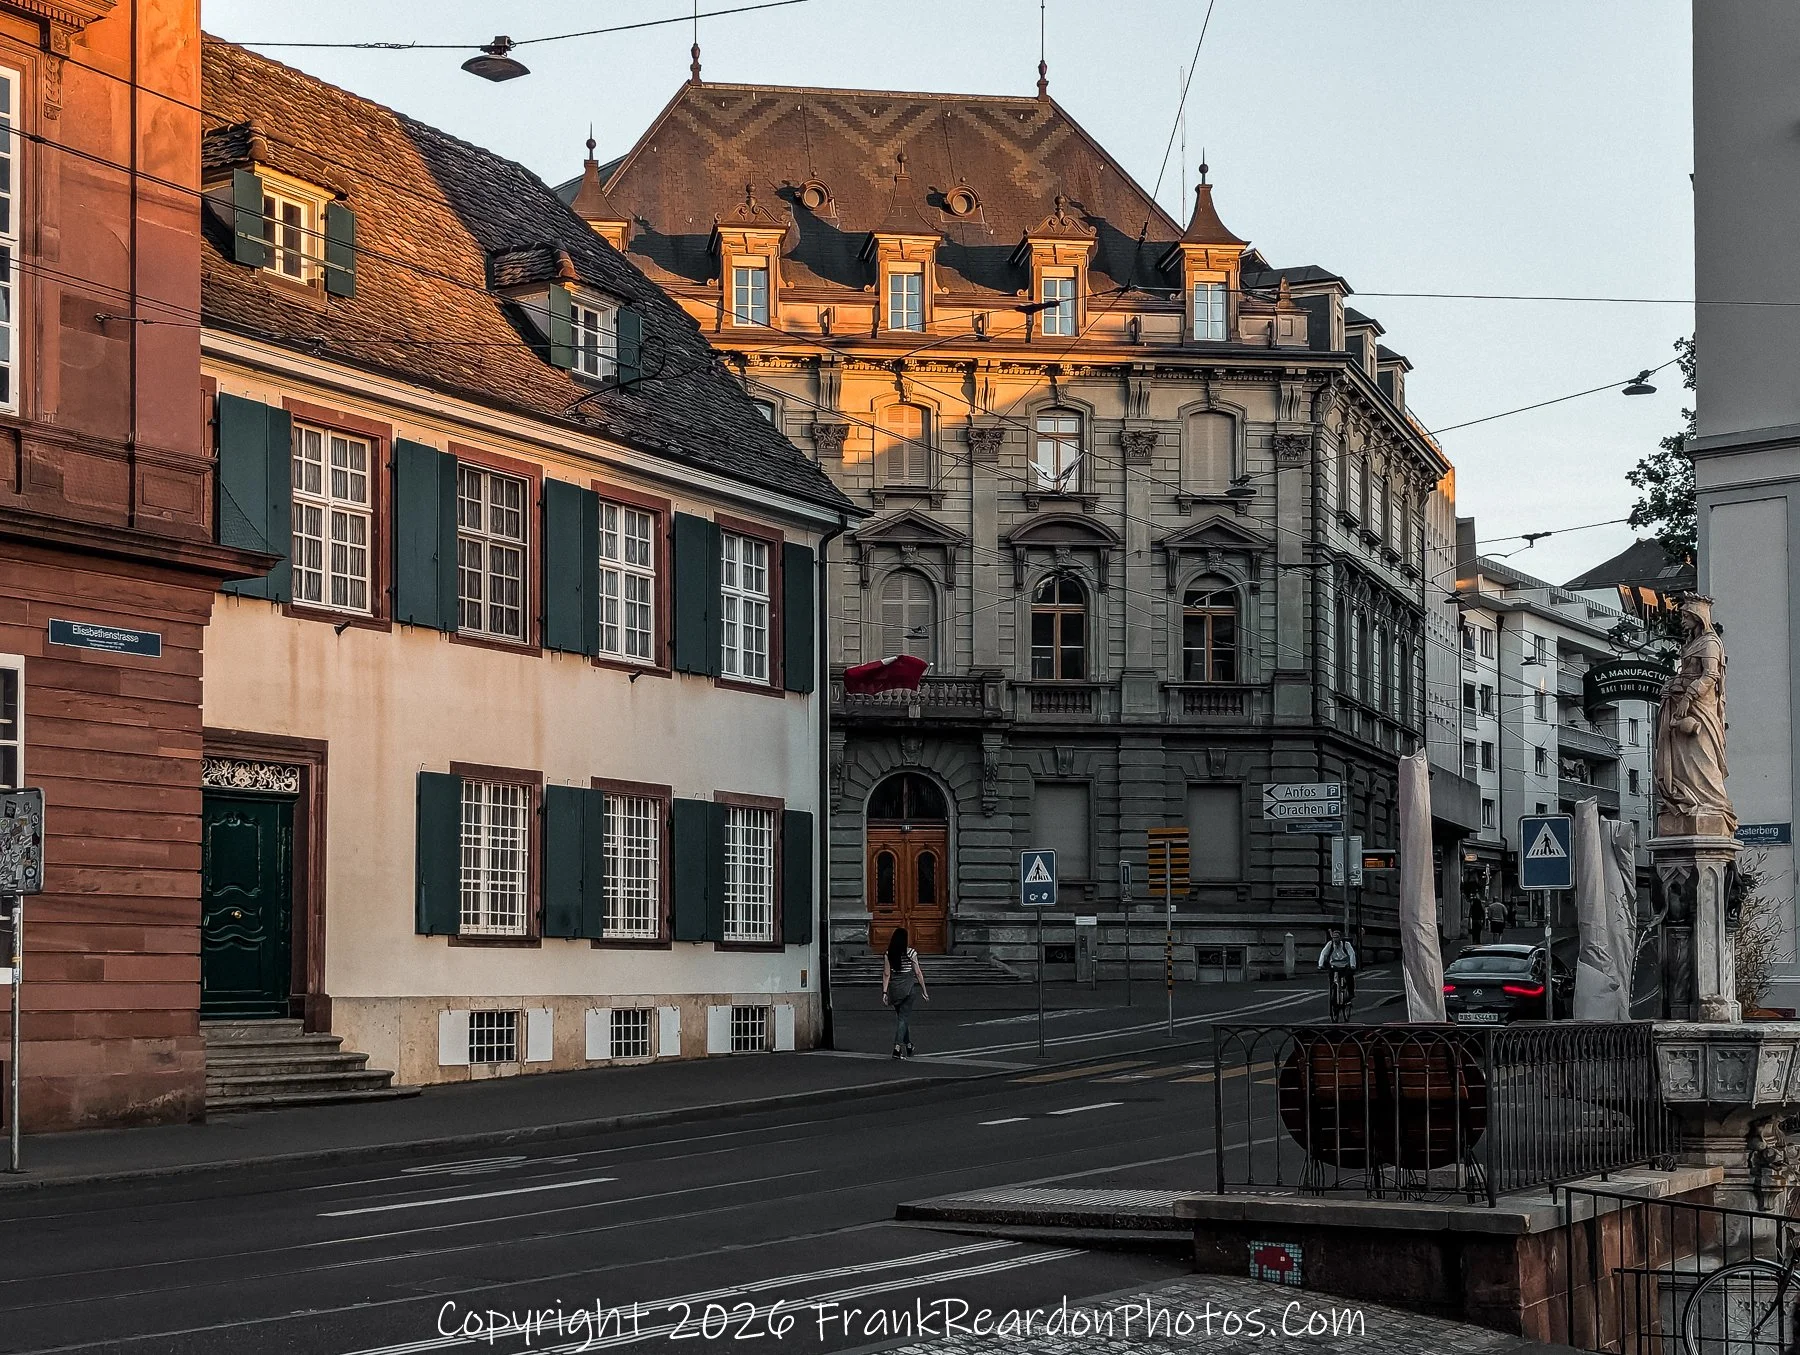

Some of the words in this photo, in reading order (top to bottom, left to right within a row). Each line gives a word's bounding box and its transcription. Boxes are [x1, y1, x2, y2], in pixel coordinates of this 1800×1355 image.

[72, 624, 139, 643] Elisabethenstrasse
[1594, 672, 1607, 682] LA
[1608, 668, 1671, 681] MANUFACTUR
[1284, 785, 1317, 798] Anfos
[1279, 803, 1324, 816] Drachen
[1737, 826, 1779, 836] osterberg
